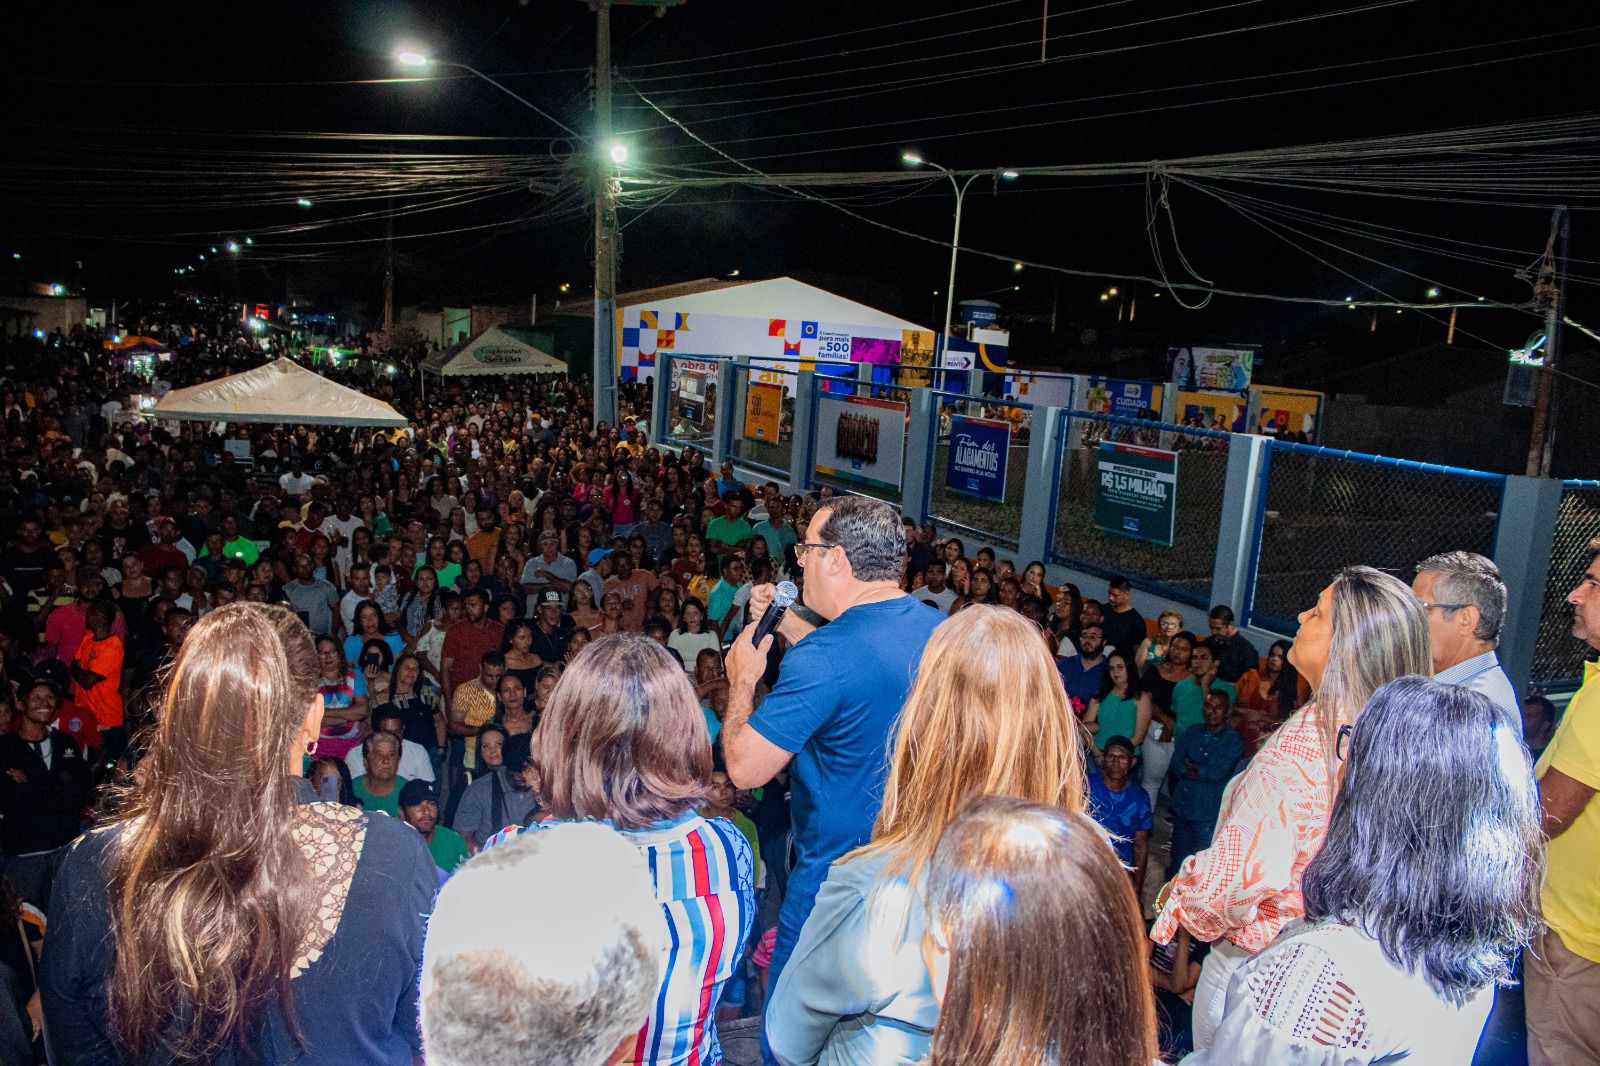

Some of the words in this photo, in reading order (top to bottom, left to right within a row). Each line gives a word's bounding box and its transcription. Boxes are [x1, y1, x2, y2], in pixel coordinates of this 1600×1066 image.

[826, 342, 849, 352] 500
[681, 361, 705, 370] obra
[1116, 397, 1147, 408] CUIDADO
[955, 433, 979, 447] Fim
[982, 440, 995, 451] dos
[955, 445, 999, 472] ALAGAMENTOS
[985, 471, 997, 479] NOVA
[1101, 472, 1113, 488] R$
[1115, 475, 1127, 491] 1,5
[1128, 477, 1167, 501] MILHÃO,
